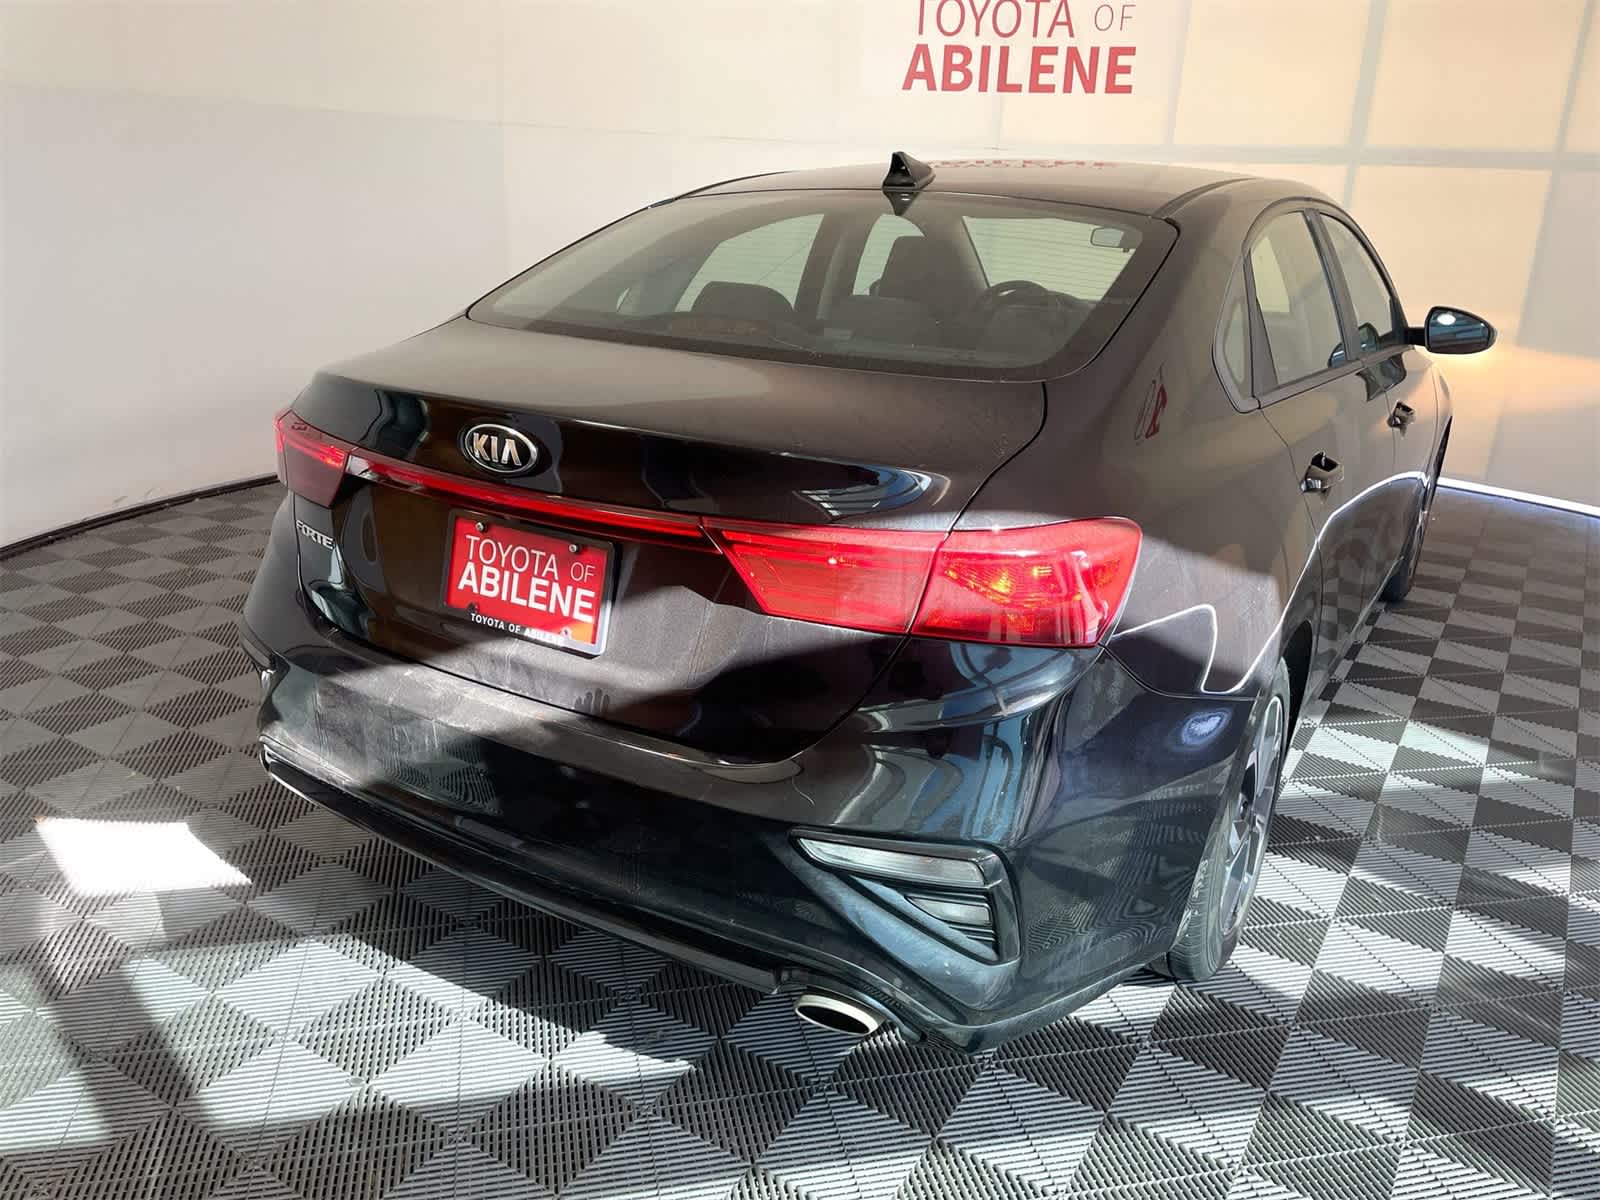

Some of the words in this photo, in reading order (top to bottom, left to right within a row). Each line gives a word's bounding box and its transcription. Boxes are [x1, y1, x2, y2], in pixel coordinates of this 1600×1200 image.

[917, 0, 1075, 38] TOYOTA
[1094, 4, 1136, 31] OF
[902, 43, 1136, 94] ABILENE
[472, 432, 522, 466] KIA
[296, 519, 334, 550] FORTE
[466, 535, 559, 580] TOYOTA
[570, 561, 596, 583] OF
[458, 561, 596, 623] ABILENE
[470, 612, 505, 630] TOYOTA
[508, 623, 521, 634] OF
